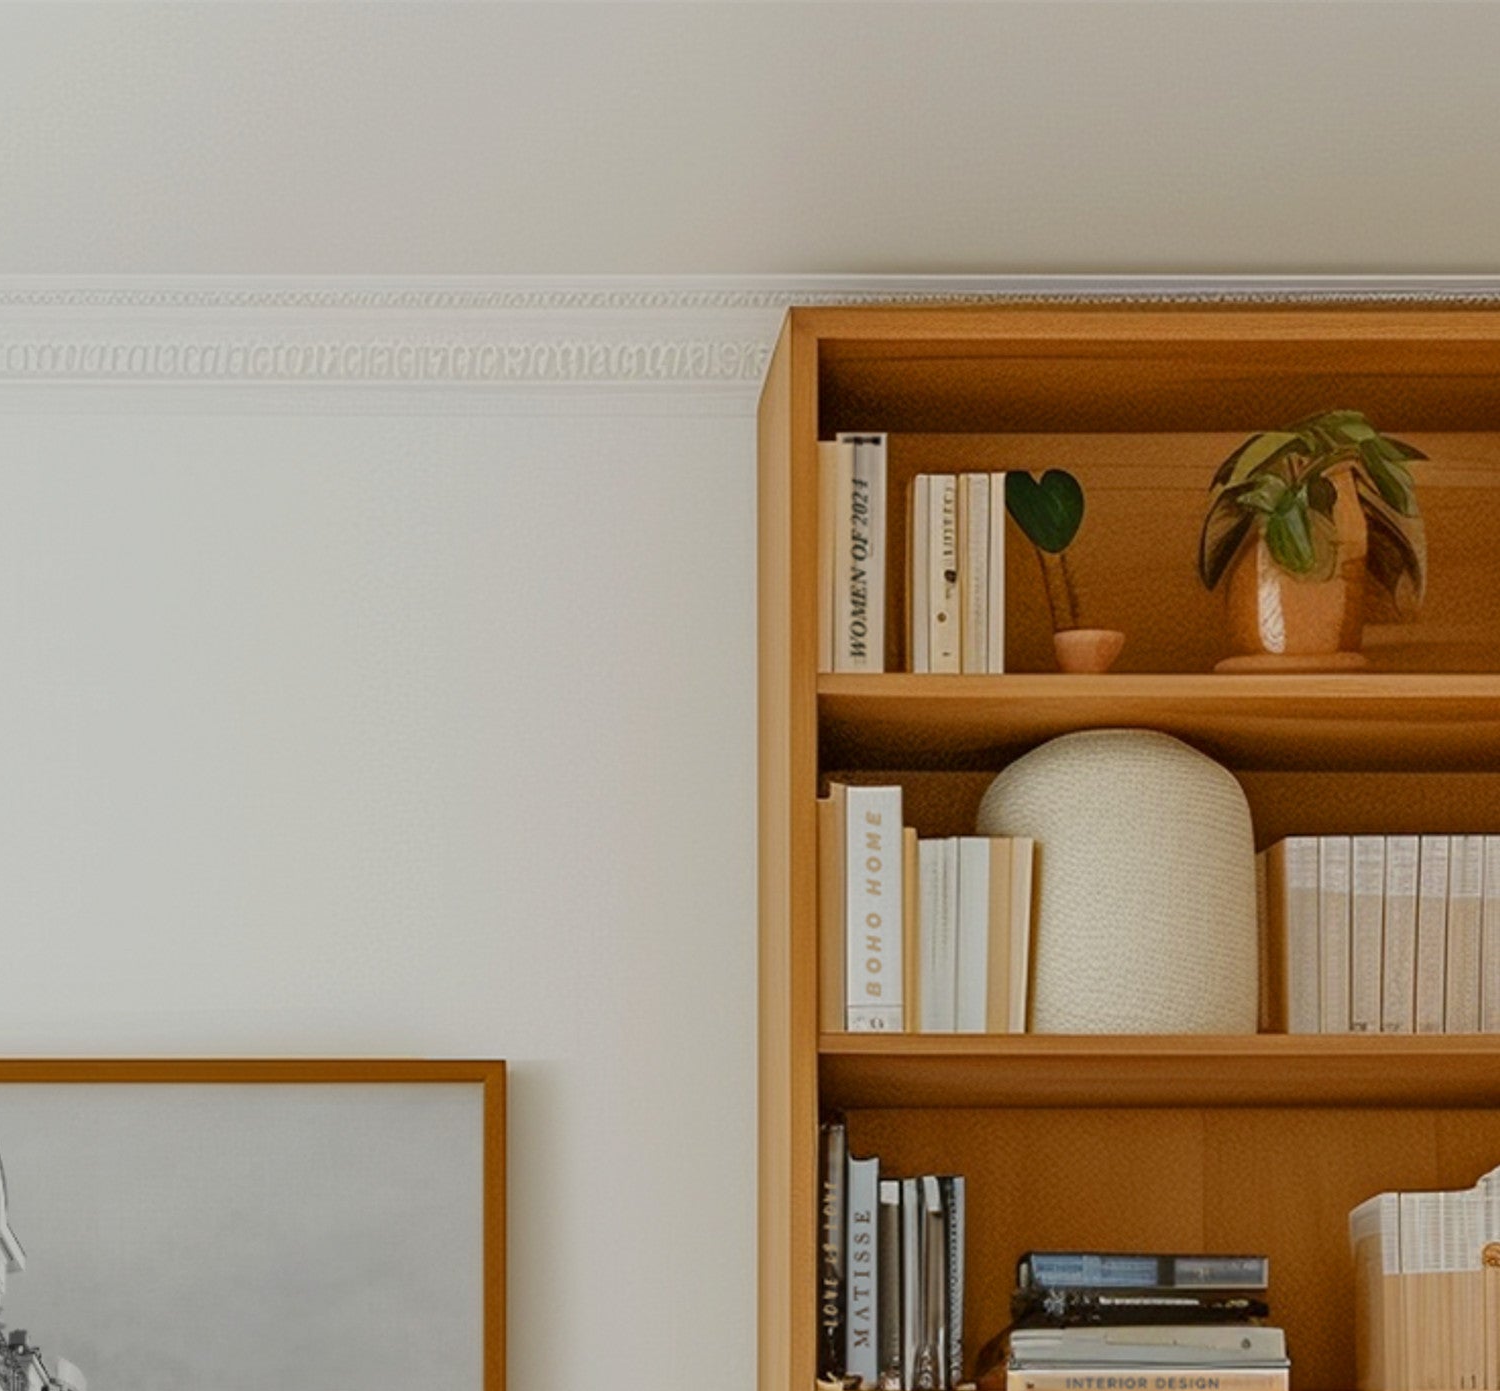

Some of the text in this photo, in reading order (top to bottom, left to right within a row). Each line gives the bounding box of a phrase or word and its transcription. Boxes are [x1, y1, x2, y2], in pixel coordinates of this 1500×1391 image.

[850, 477, 869, 658] WOMEN OF 2024
[865, 811, 883, 897] HOME
[865, 912, 883, 998] BOHO
[822, 1181, 839, 1231] LOVE
[822, 1277, 839, 1328] LOVE
[853, 1210, 871, 1347] MATISSE
[1065, 1376, 1220, 1389] INTERIOR DESIGN
